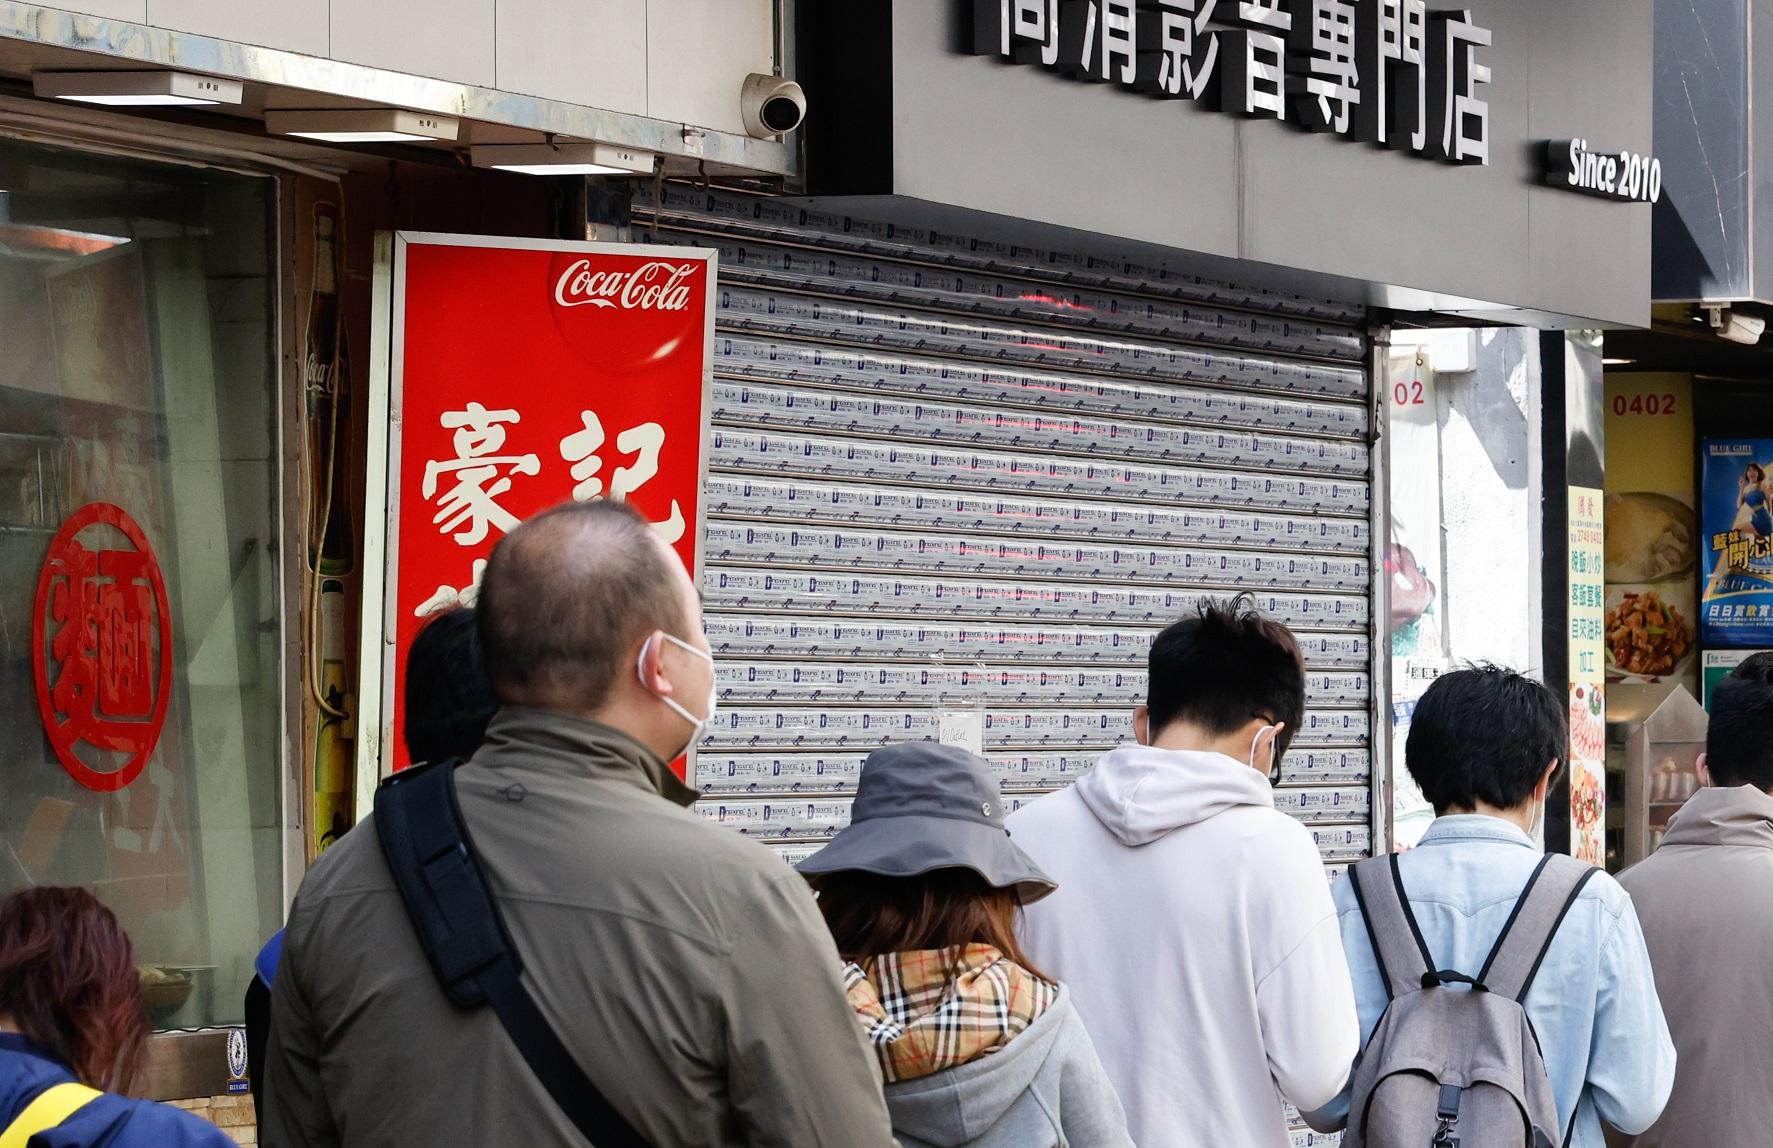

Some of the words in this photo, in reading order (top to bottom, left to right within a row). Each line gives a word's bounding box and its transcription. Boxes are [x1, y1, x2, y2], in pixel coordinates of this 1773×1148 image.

[1568, 138, 1616, 194] Since
[1618, 151, 1661, 202] 2010
[554, 258, 700, 311] Coca-Cola
[1613, 394, 1676, 418] 0402
